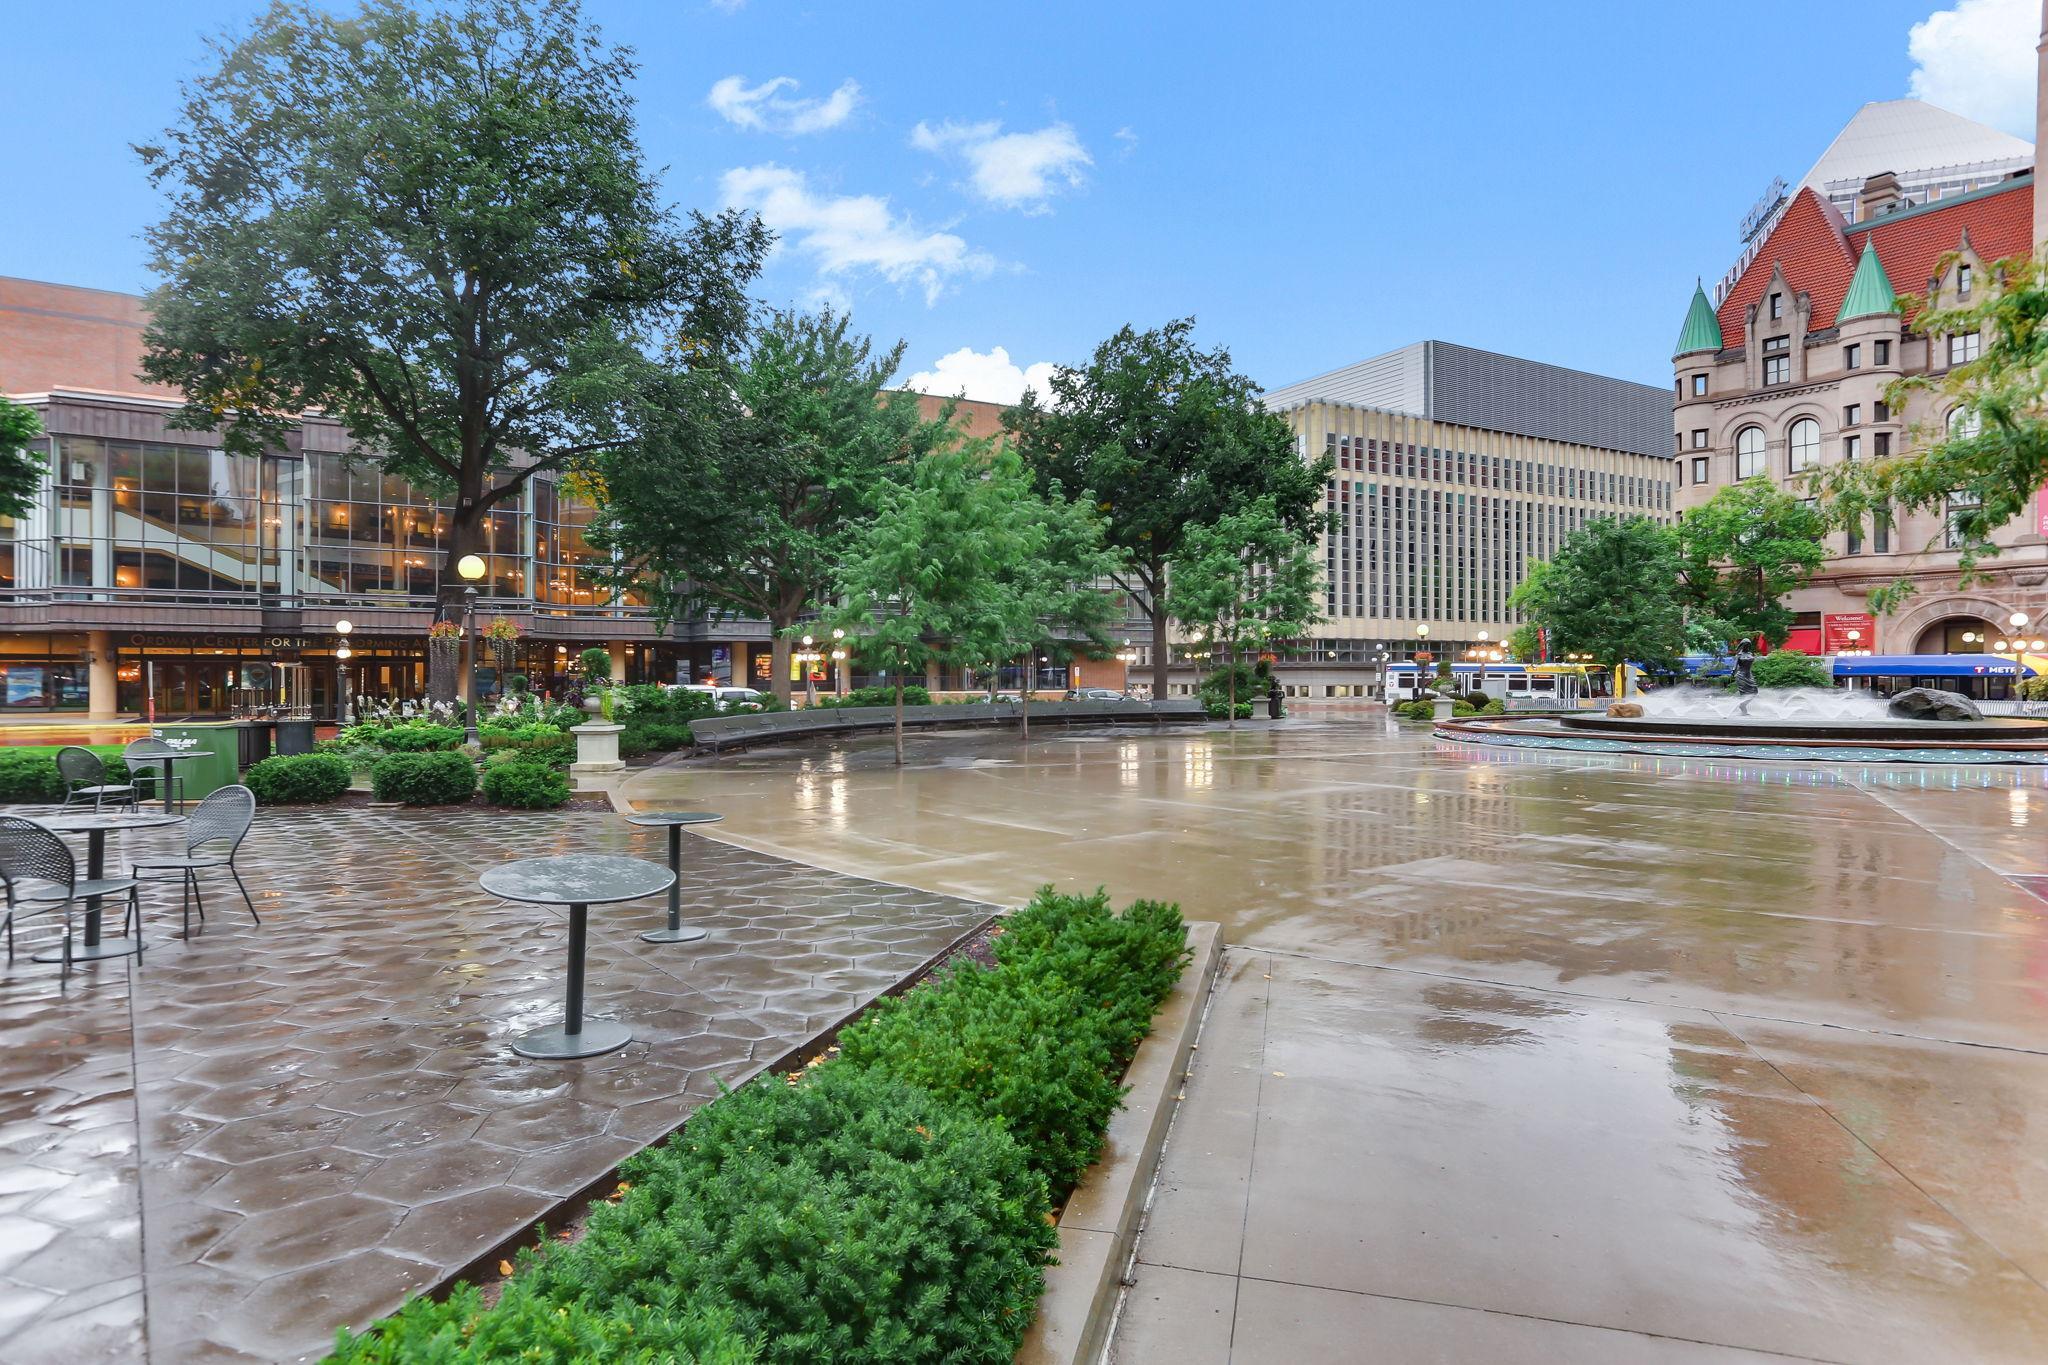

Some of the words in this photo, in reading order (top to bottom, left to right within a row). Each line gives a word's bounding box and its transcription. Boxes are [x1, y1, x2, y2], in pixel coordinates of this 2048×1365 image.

[130, 633, 198, 646] ORDWAY
[203, 634, 259, 647] CENTER
[264, 637, 291, 647] FOR
[294, 637, 319, 647] THE
[326, 637, 408, 648] PEORMING
